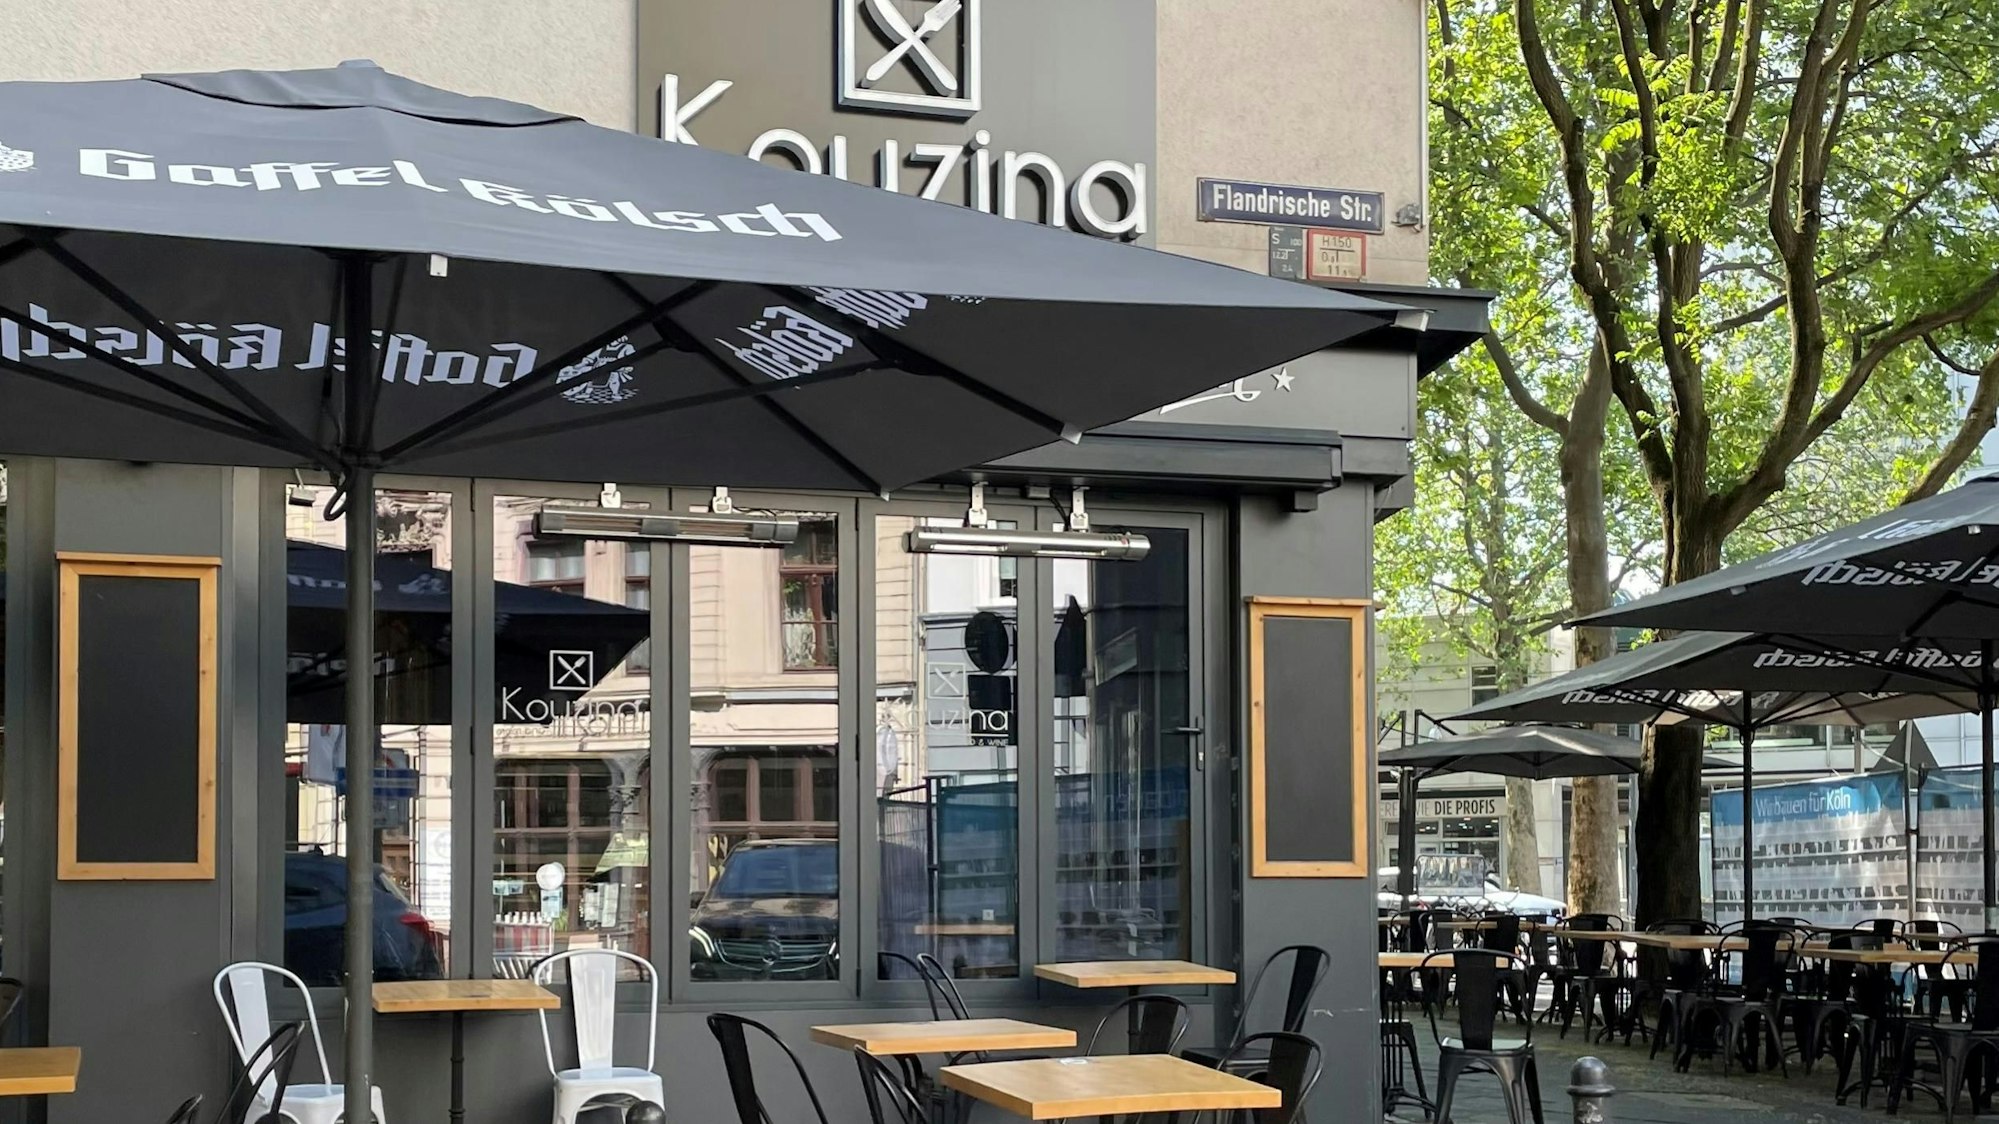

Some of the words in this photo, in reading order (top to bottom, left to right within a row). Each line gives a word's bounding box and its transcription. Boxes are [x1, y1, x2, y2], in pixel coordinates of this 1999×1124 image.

[79, 147, 447, 192] Gaffel
[459, 176, 843, 242] Kölsch
[1212, 184, 1331, 218] Flandrische
[1340, 194, 1372, 222] Str.
[1434, 800, 1452, 816] DIE
[1455, 799, 1495, 816] PROFIS
[1809, 791, 1826, 812] für
[1826, 788, 1851, 810] Köln
